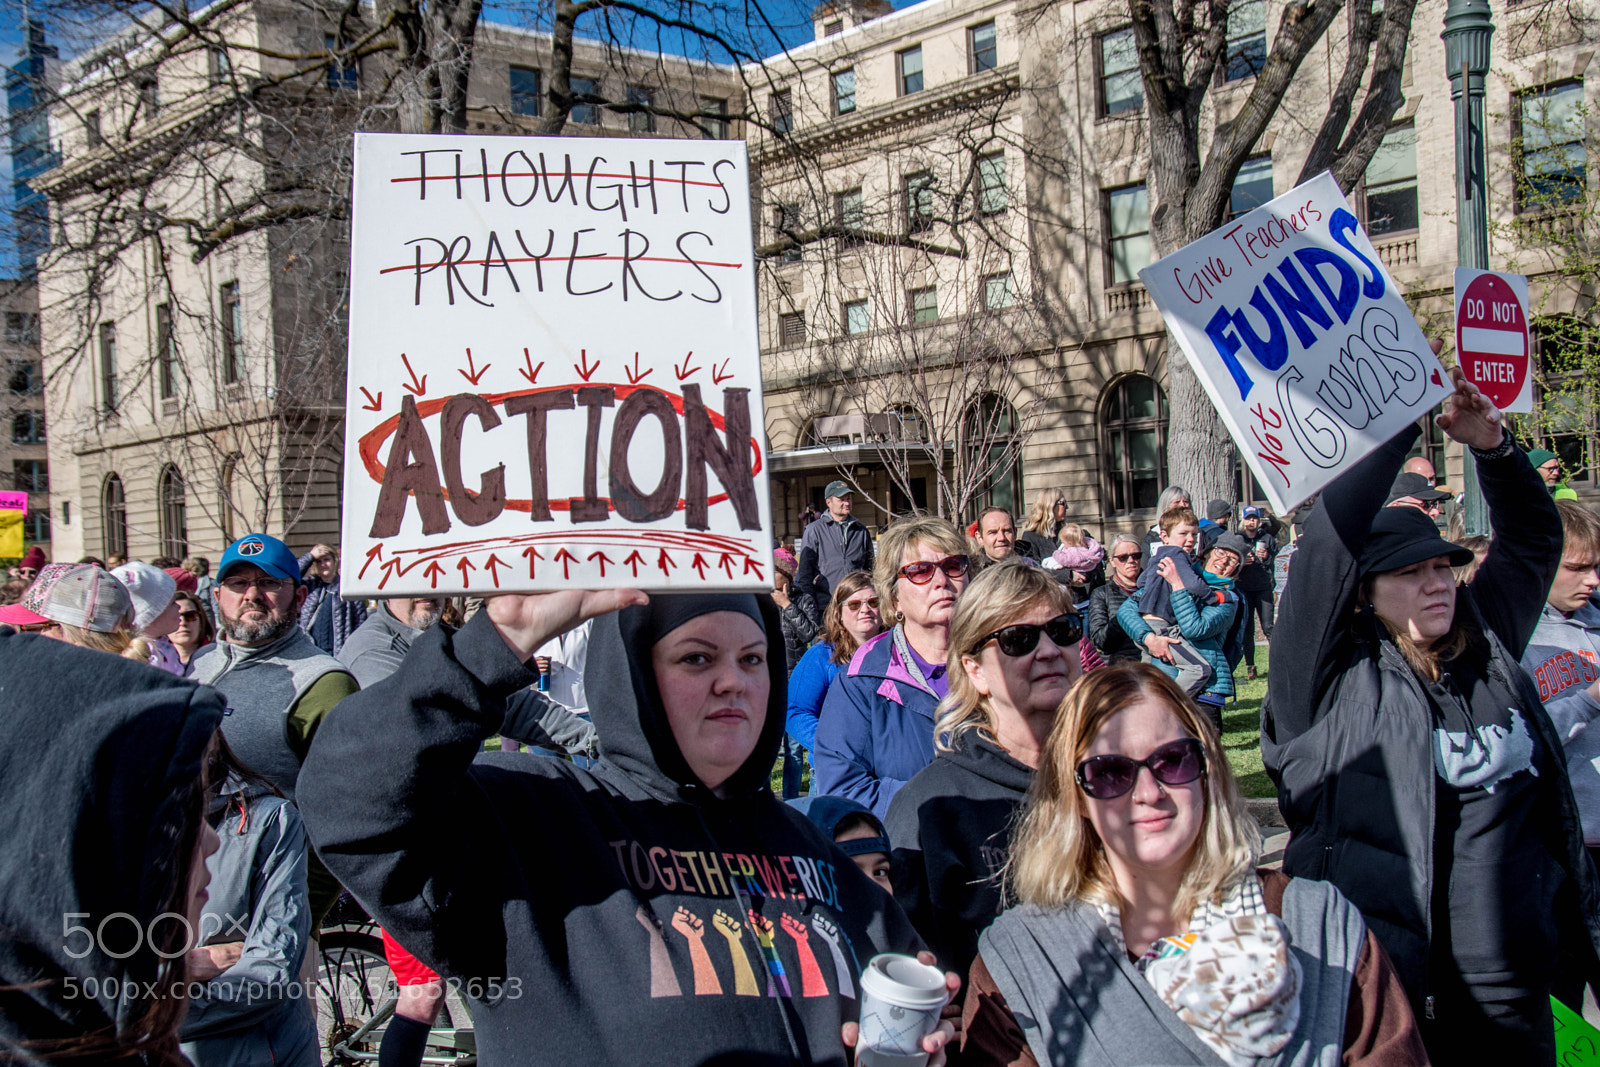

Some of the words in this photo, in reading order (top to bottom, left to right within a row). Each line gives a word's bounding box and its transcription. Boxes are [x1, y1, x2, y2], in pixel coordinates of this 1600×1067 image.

[401, 148, 736, 222] THOUGHTS
[404, 228, 722, 307] PRAYERS
[1174, 256, 1232, 304] Give
[1223, 200, 1322, 267] Teachers
[1204, 207, 1386, 402] FUNDS
[1467, 298, 1485, 321] DO
[1492, 301, 1517, 324] NOT
[1474, 360, 1515, 384] ENTER
[368, 383, 762, 539] ACTION
[1534, 650, 1581, 703] BOISE
